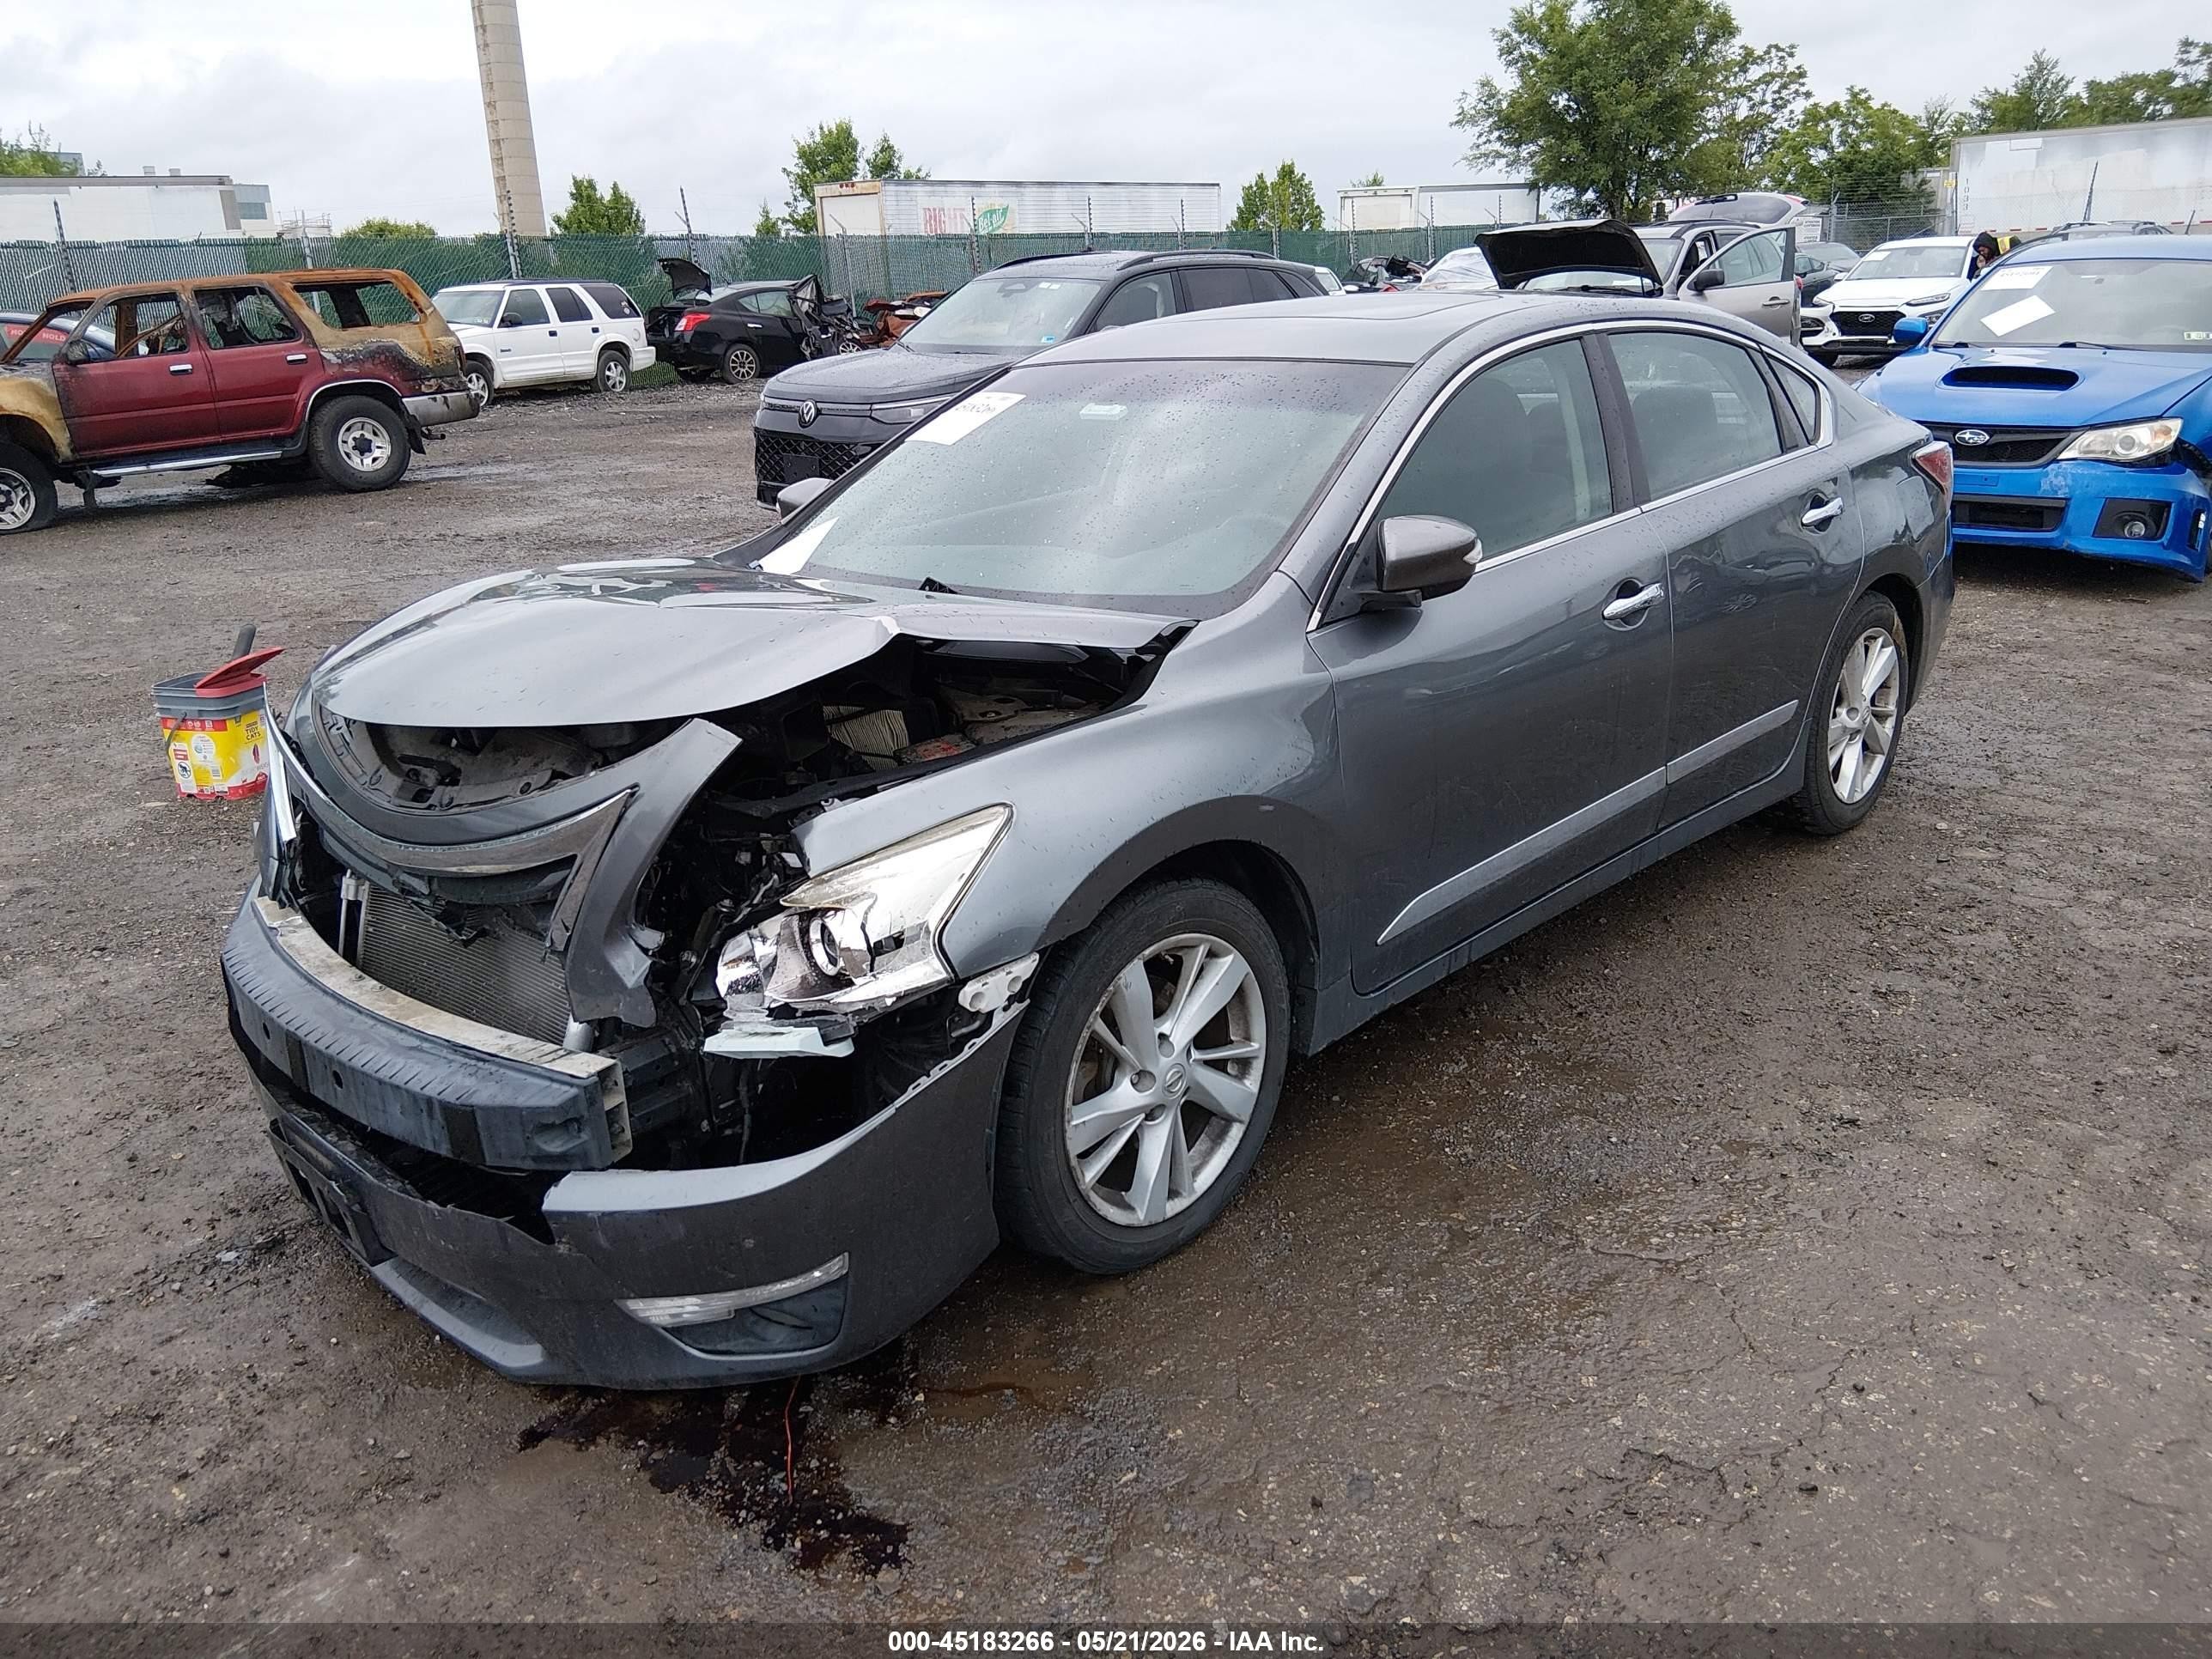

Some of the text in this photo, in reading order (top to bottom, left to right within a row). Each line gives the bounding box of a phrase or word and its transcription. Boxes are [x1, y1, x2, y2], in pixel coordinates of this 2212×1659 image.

[42, 332, 66, 342] HOLD
[246, 726, 258, 734] TIDY
[246, 731, 261, 740] CATS
